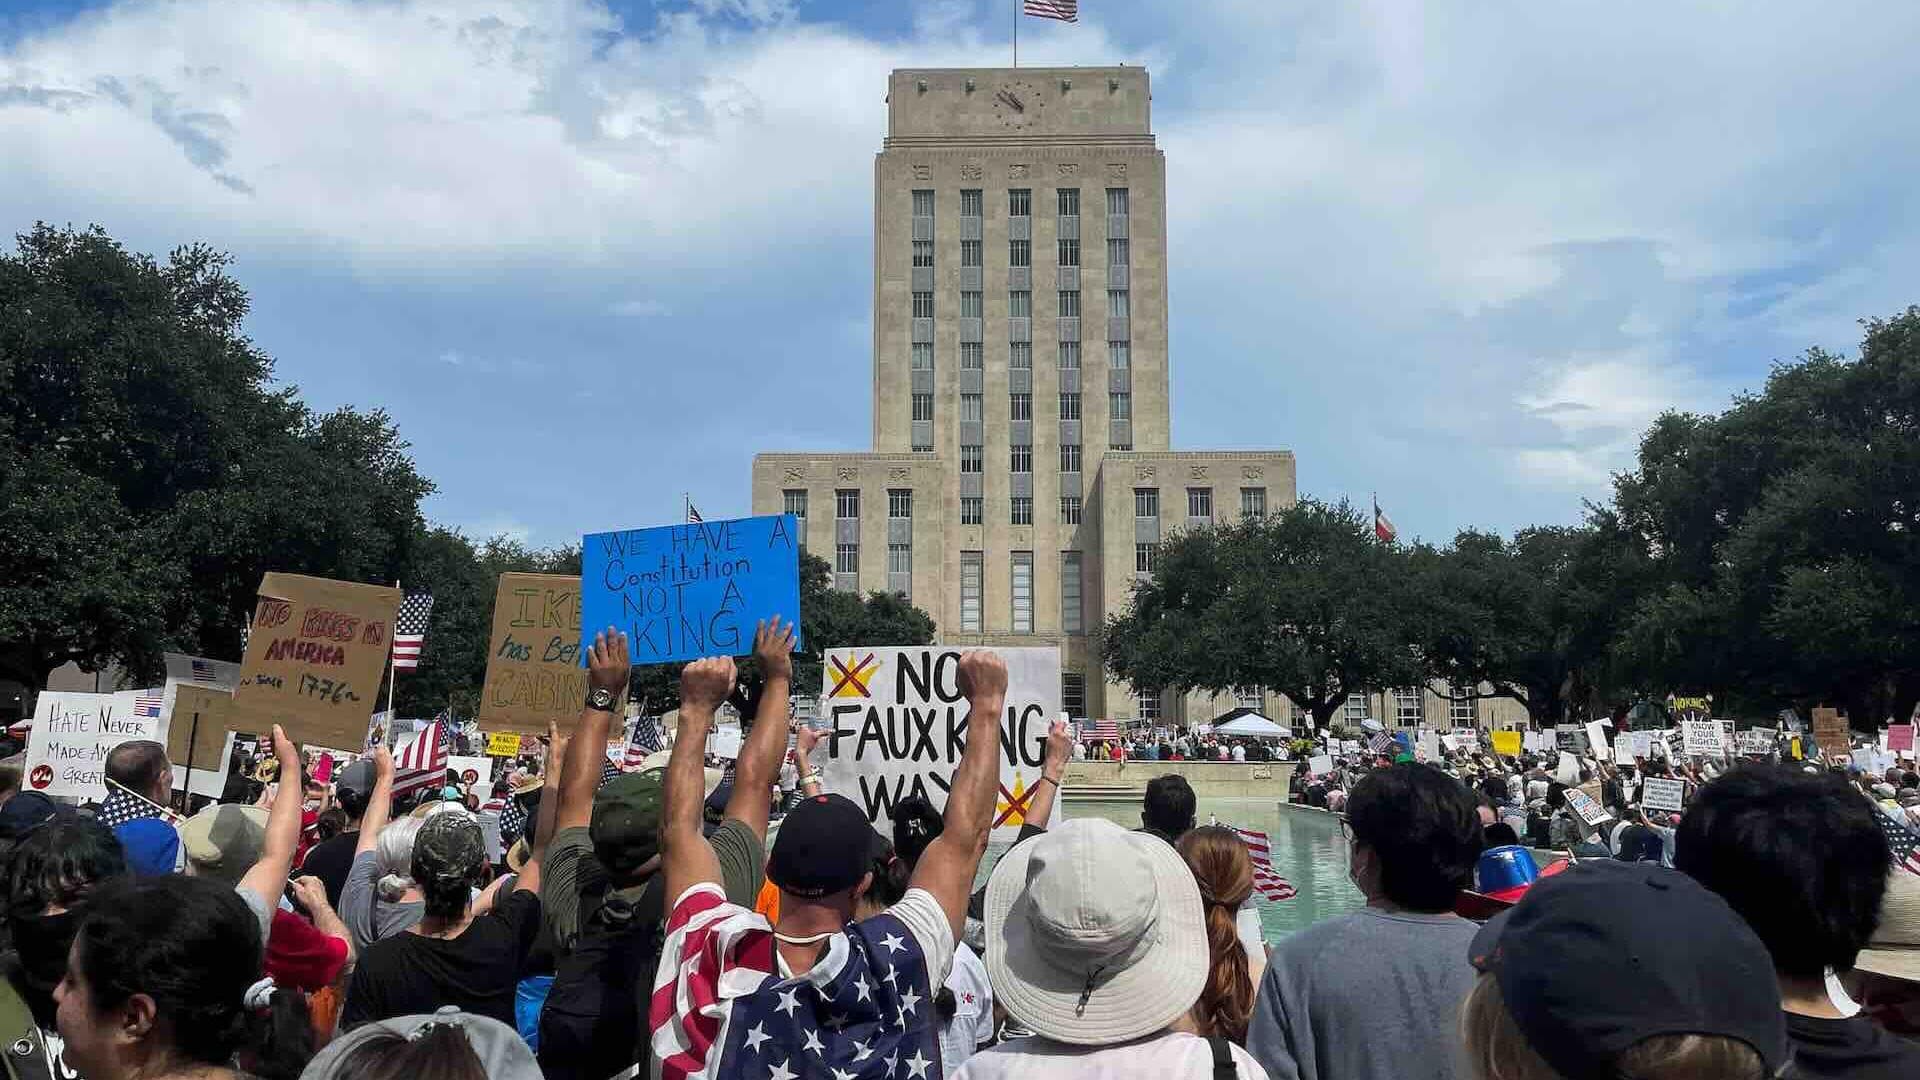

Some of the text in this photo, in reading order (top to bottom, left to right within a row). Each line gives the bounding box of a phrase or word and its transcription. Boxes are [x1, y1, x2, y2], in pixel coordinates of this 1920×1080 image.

[601, 515, 792, 557] WE HAVE A
[605, 552, 750, 591] Constitution
[623, 578, 745, 619] NOT A
[257, 601, 291, 629] NO
[497, 633, 533, 662] has
[633, 609, 741, 658] KING
[263, 637, 345, 666] AMERICA
[896, 651, 962, 704] NO
[48, 702, 146, 735] HATE NEVER
[1691, 722, 1716, 730] KNOW
[1693, 730, 1715, 738] YOUR
[829, 703, 1048, 767] FAUX KNG
[1689, 737, 1719, 746] RIGHTS
[48, 742, 87, 760] MADE
